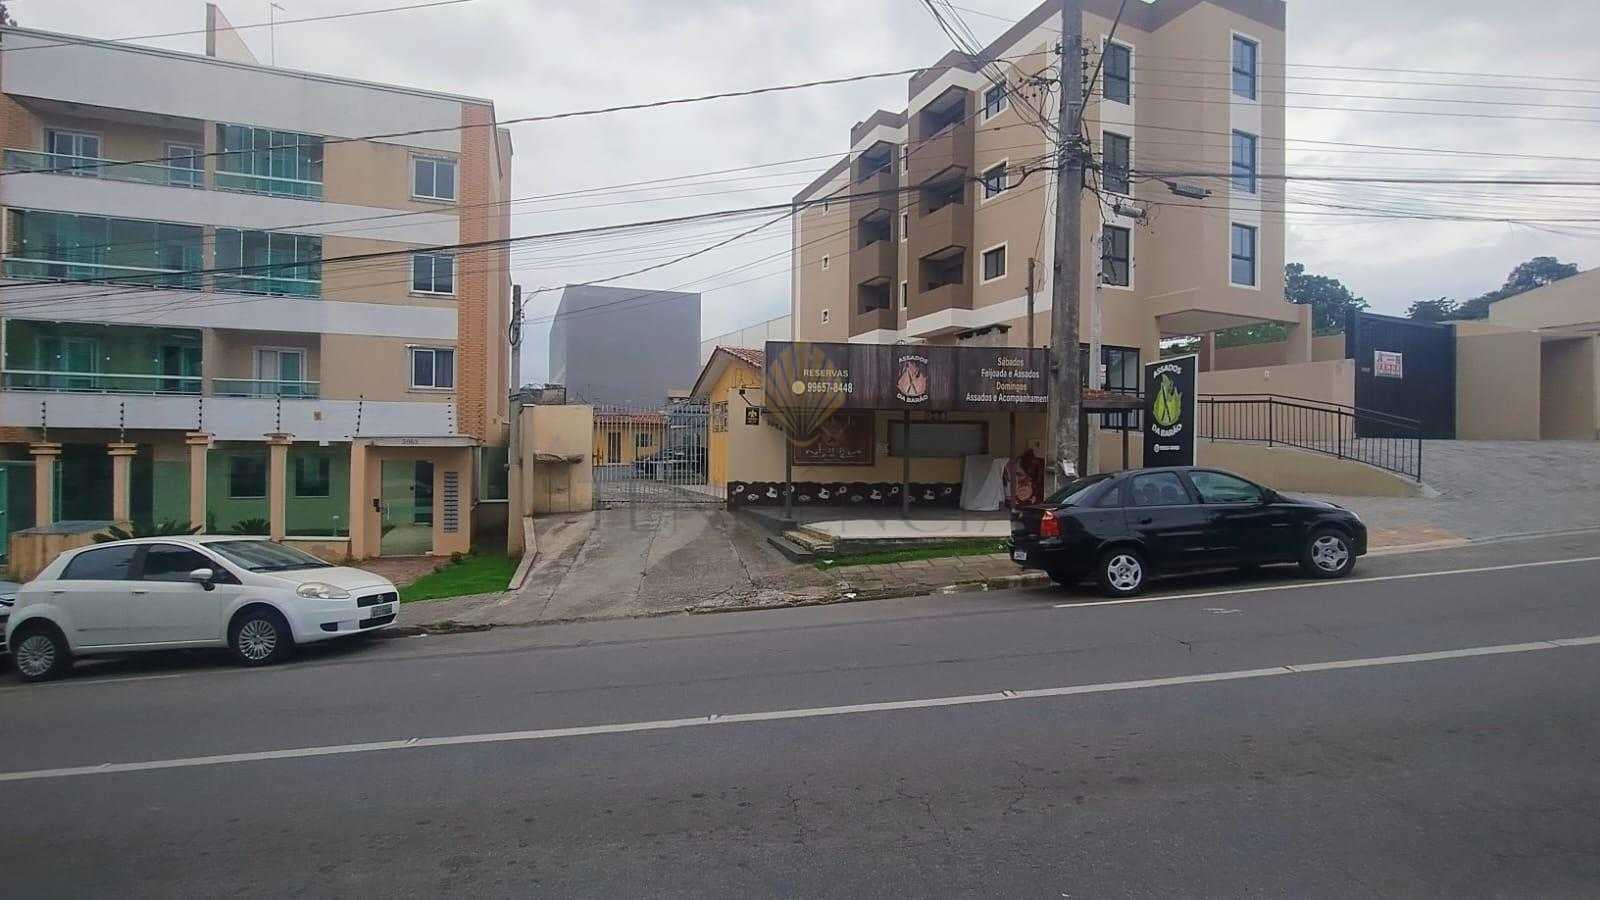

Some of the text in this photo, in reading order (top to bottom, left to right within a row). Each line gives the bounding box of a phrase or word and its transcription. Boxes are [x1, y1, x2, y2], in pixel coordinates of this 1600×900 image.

[898, 355, 928, 365] ASSADOS
[997, 356, 1025, 367] Sábados
[803, 368, 849, 378] RESERVAS
[981, 368, 1007, 379] Feijoada
[1014, 369, 1039, 379] Assados
[1153, 364, 1181, 379] ASSADOS
[996, 381, 1027, 392] Domingos
[966, 393, 992, 402] Assados
